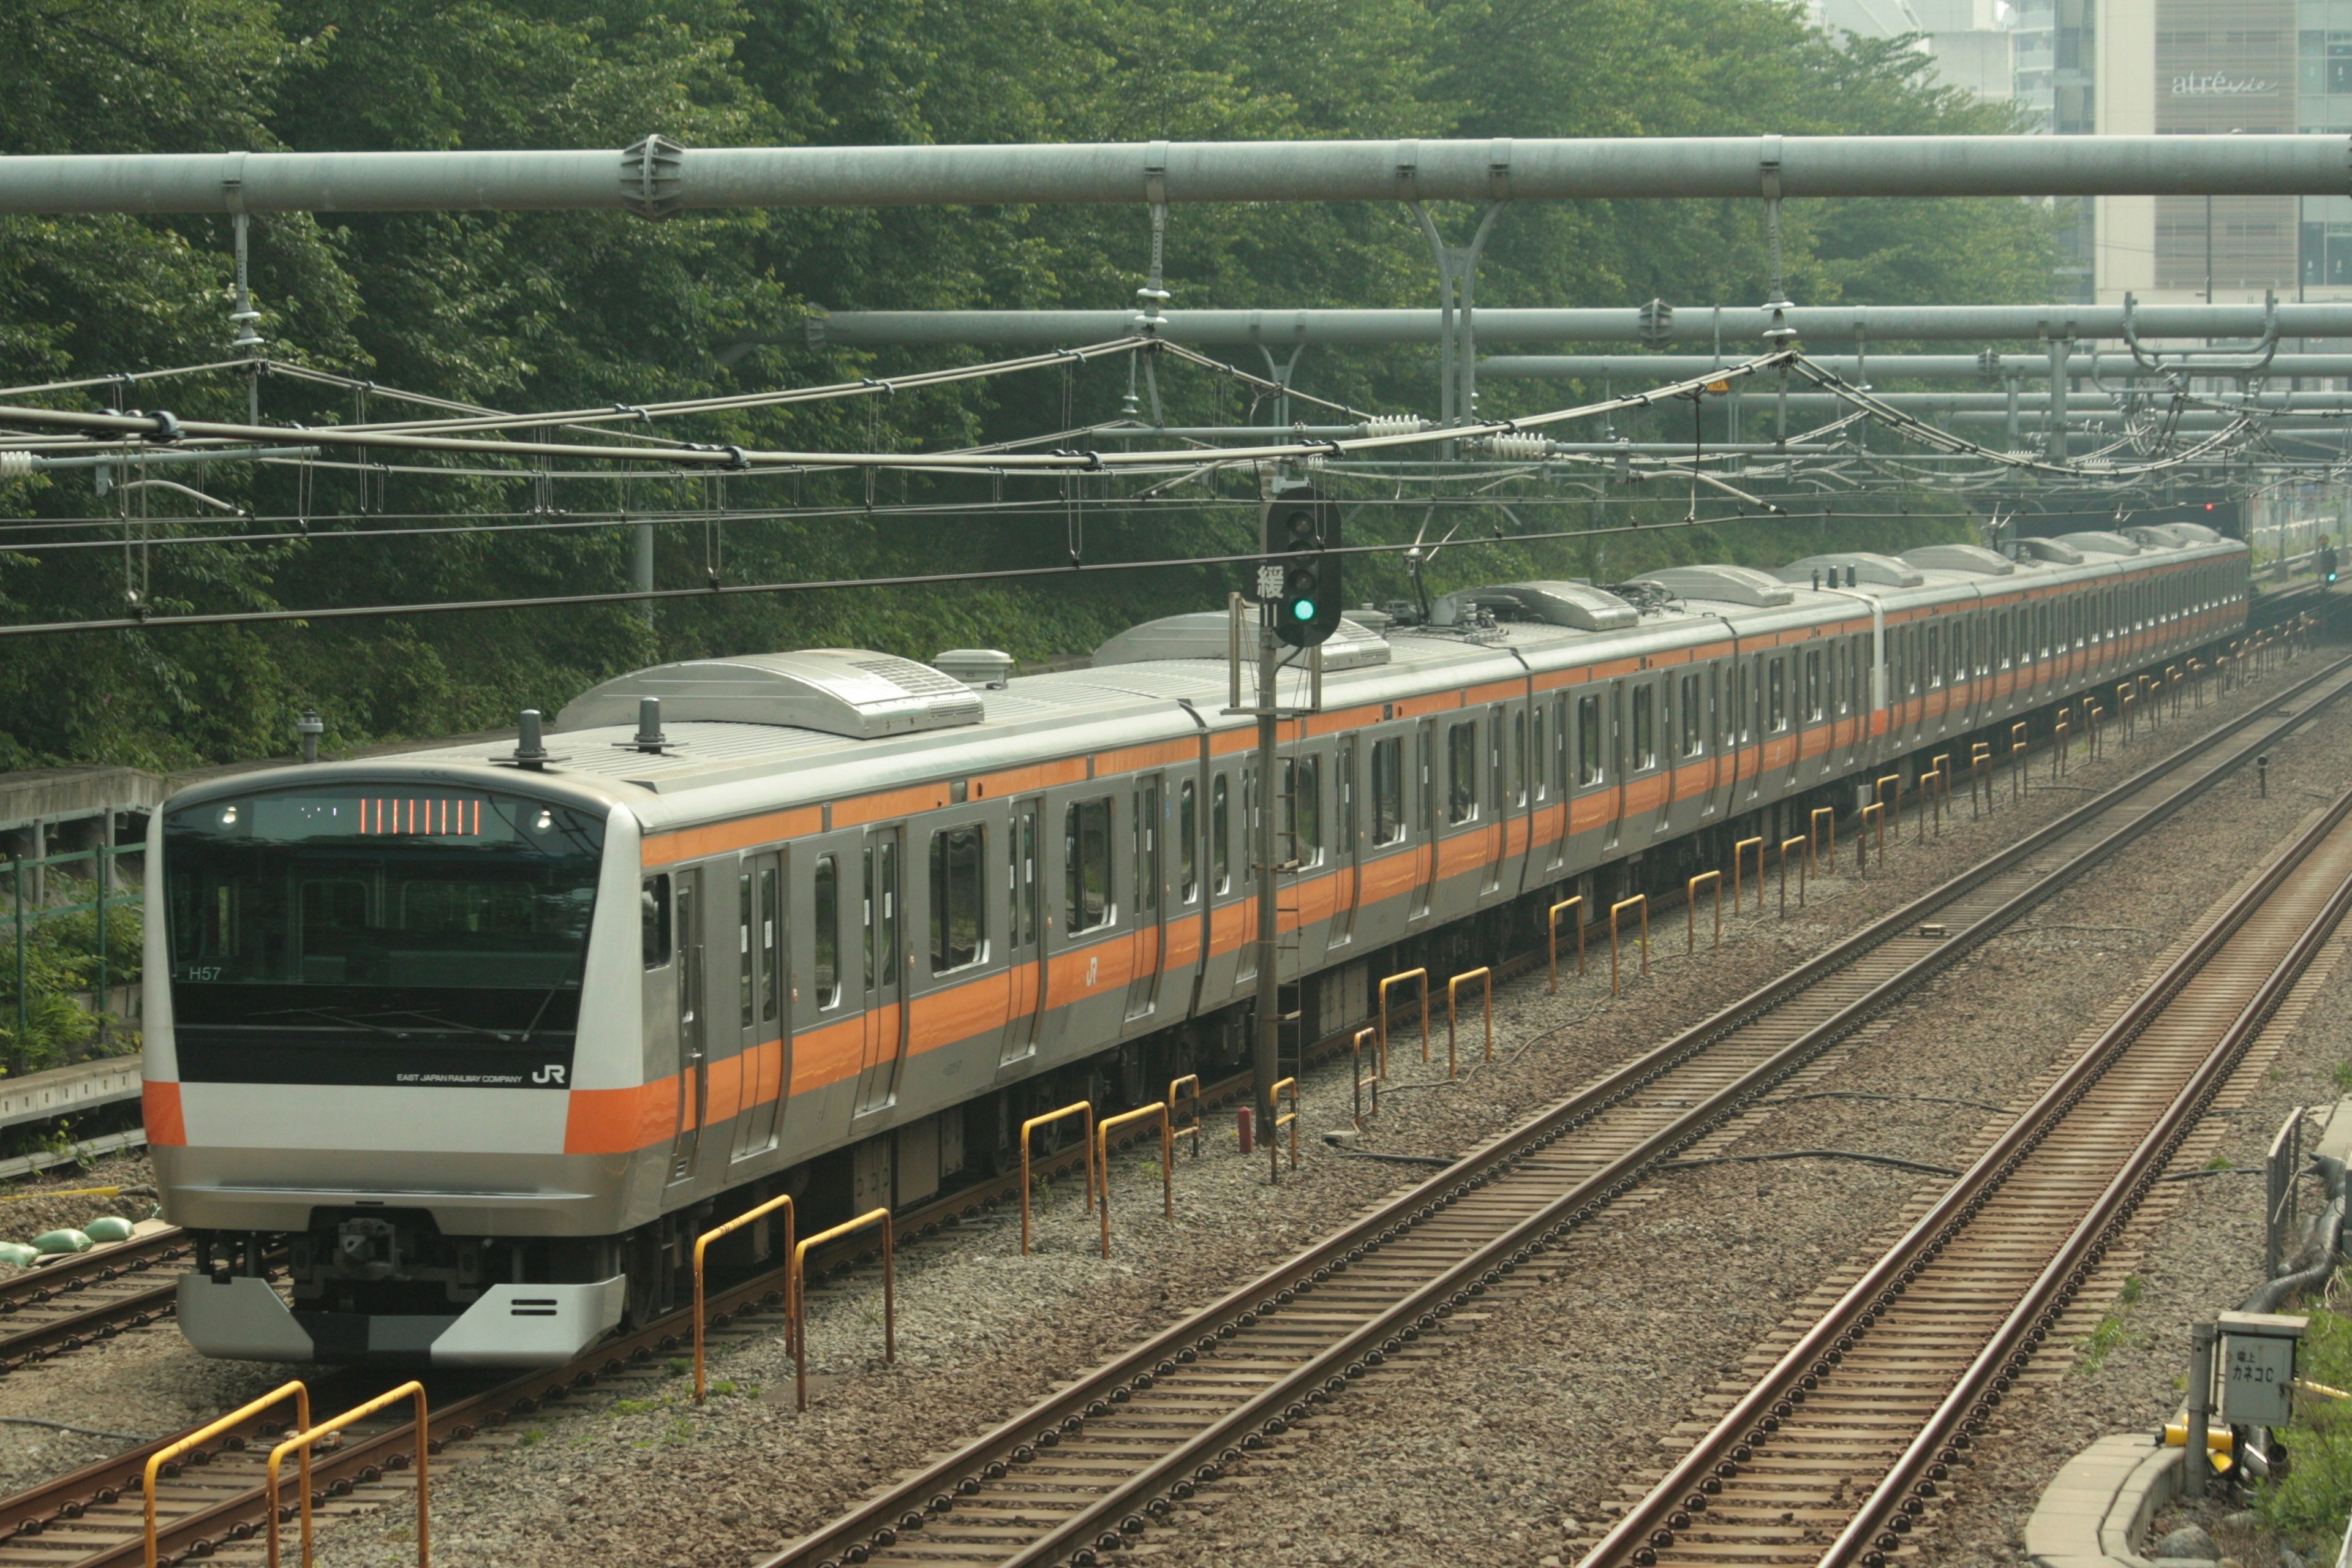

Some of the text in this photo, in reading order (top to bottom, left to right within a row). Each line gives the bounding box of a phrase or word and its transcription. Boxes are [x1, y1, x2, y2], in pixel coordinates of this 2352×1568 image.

[1257, 565, 1284, 599] 緩
[1263, 603, 1277, 627] 11
[189, 967, 222, 981] H57
[1086, 956, 1098, 987] JR
[482, 1075, 522, 1084] COMPANY
[532, 1064, 565, 1084] JR
[2233, 1365, 2274, 1383] カネコC
